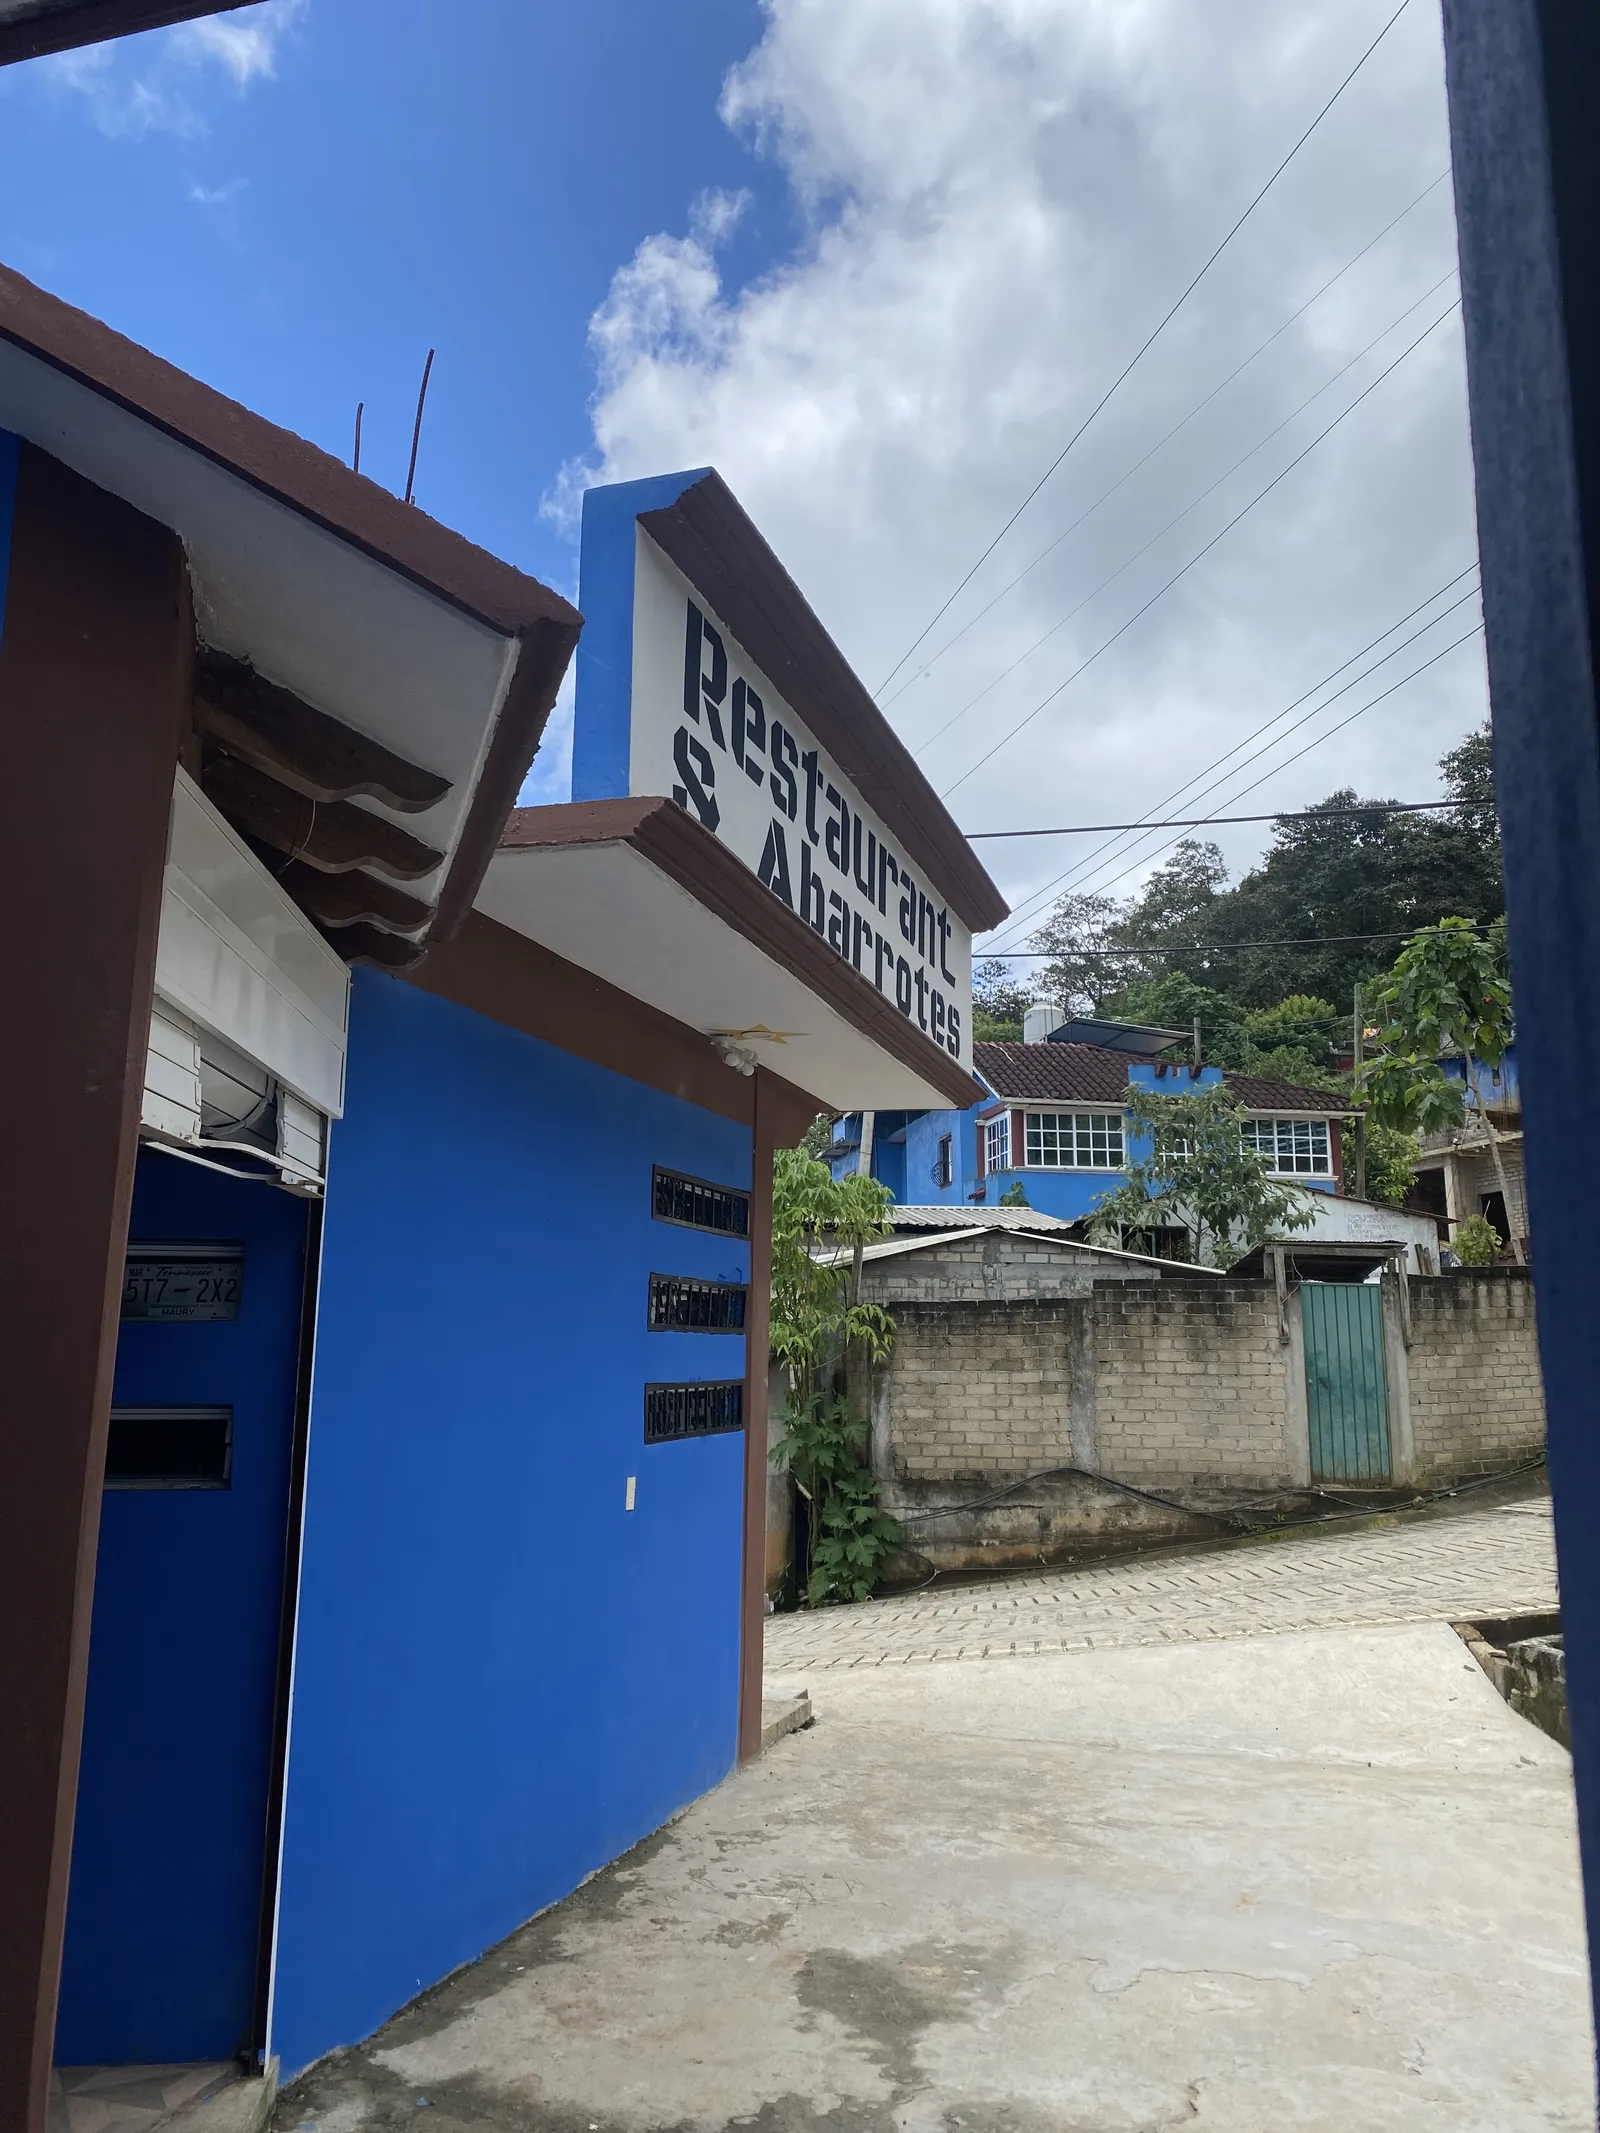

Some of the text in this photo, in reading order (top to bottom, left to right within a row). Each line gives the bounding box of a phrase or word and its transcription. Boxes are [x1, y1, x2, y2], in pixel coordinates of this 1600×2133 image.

[683, 596, 957, 989] Restaurant
[756, 816, 961, 1061] Abarrotes
[156, 1265, 214, 1278] Tennessee
[160, 1308, 196, 1316] MAURY
